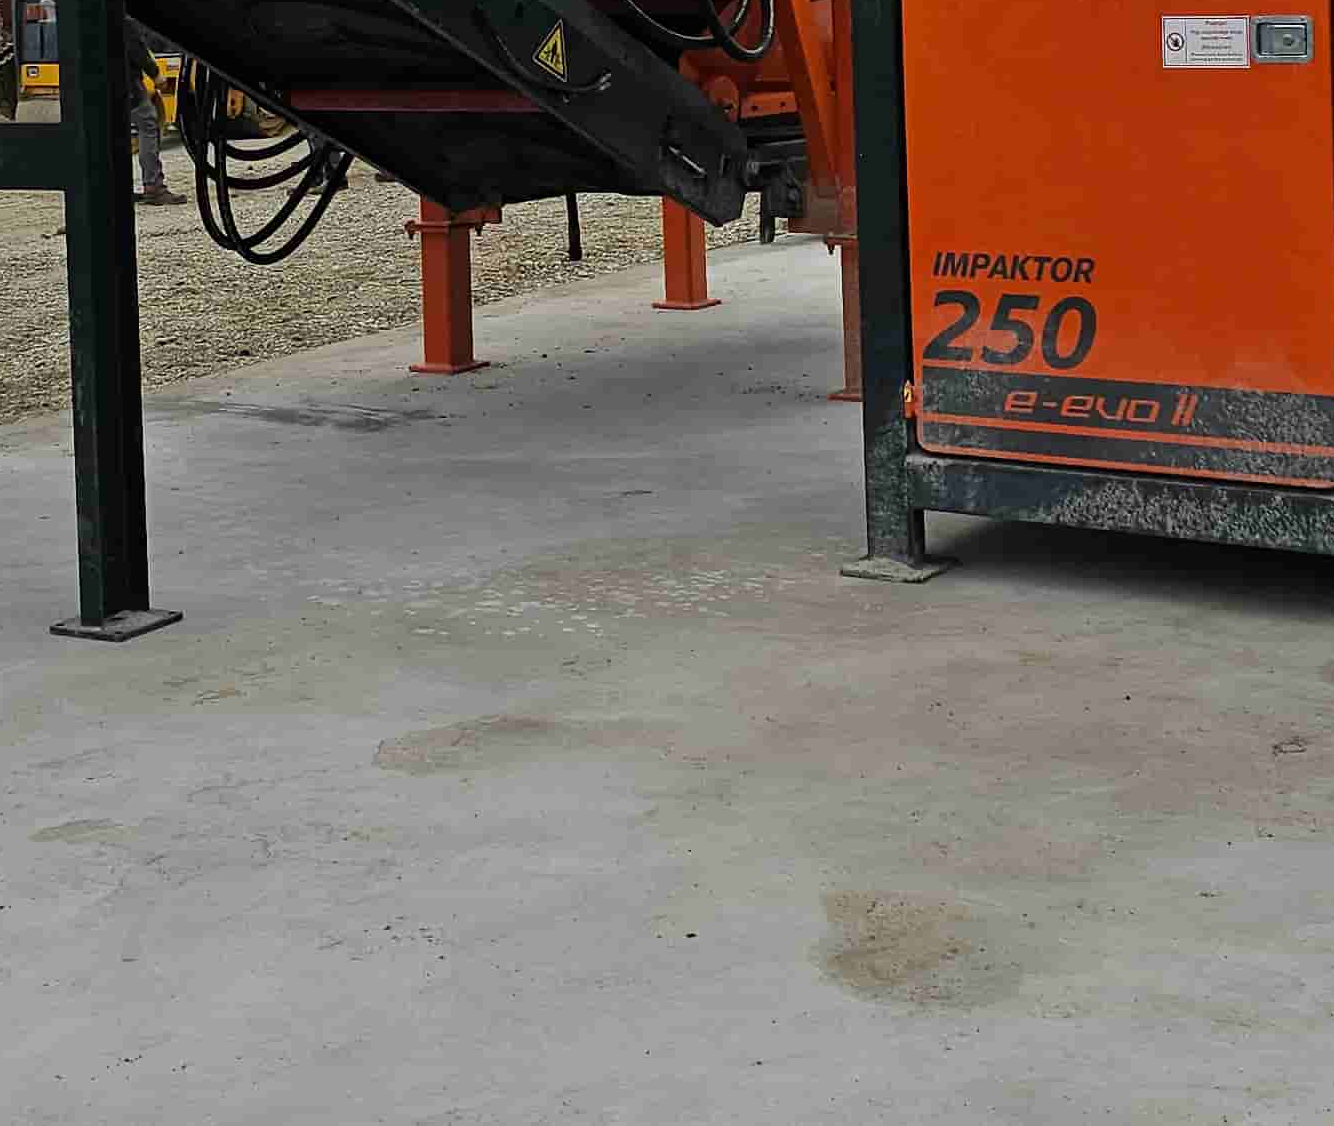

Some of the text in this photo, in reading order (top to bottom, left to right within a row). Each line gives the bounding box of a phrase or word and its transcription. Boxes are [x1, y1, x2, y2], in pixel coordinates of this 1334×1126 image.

[933, 251, 1095, 284] IMPAKTOR
[923, 290, 1097, 369] 250
[1004, 390, 1161, 424] e-evo
